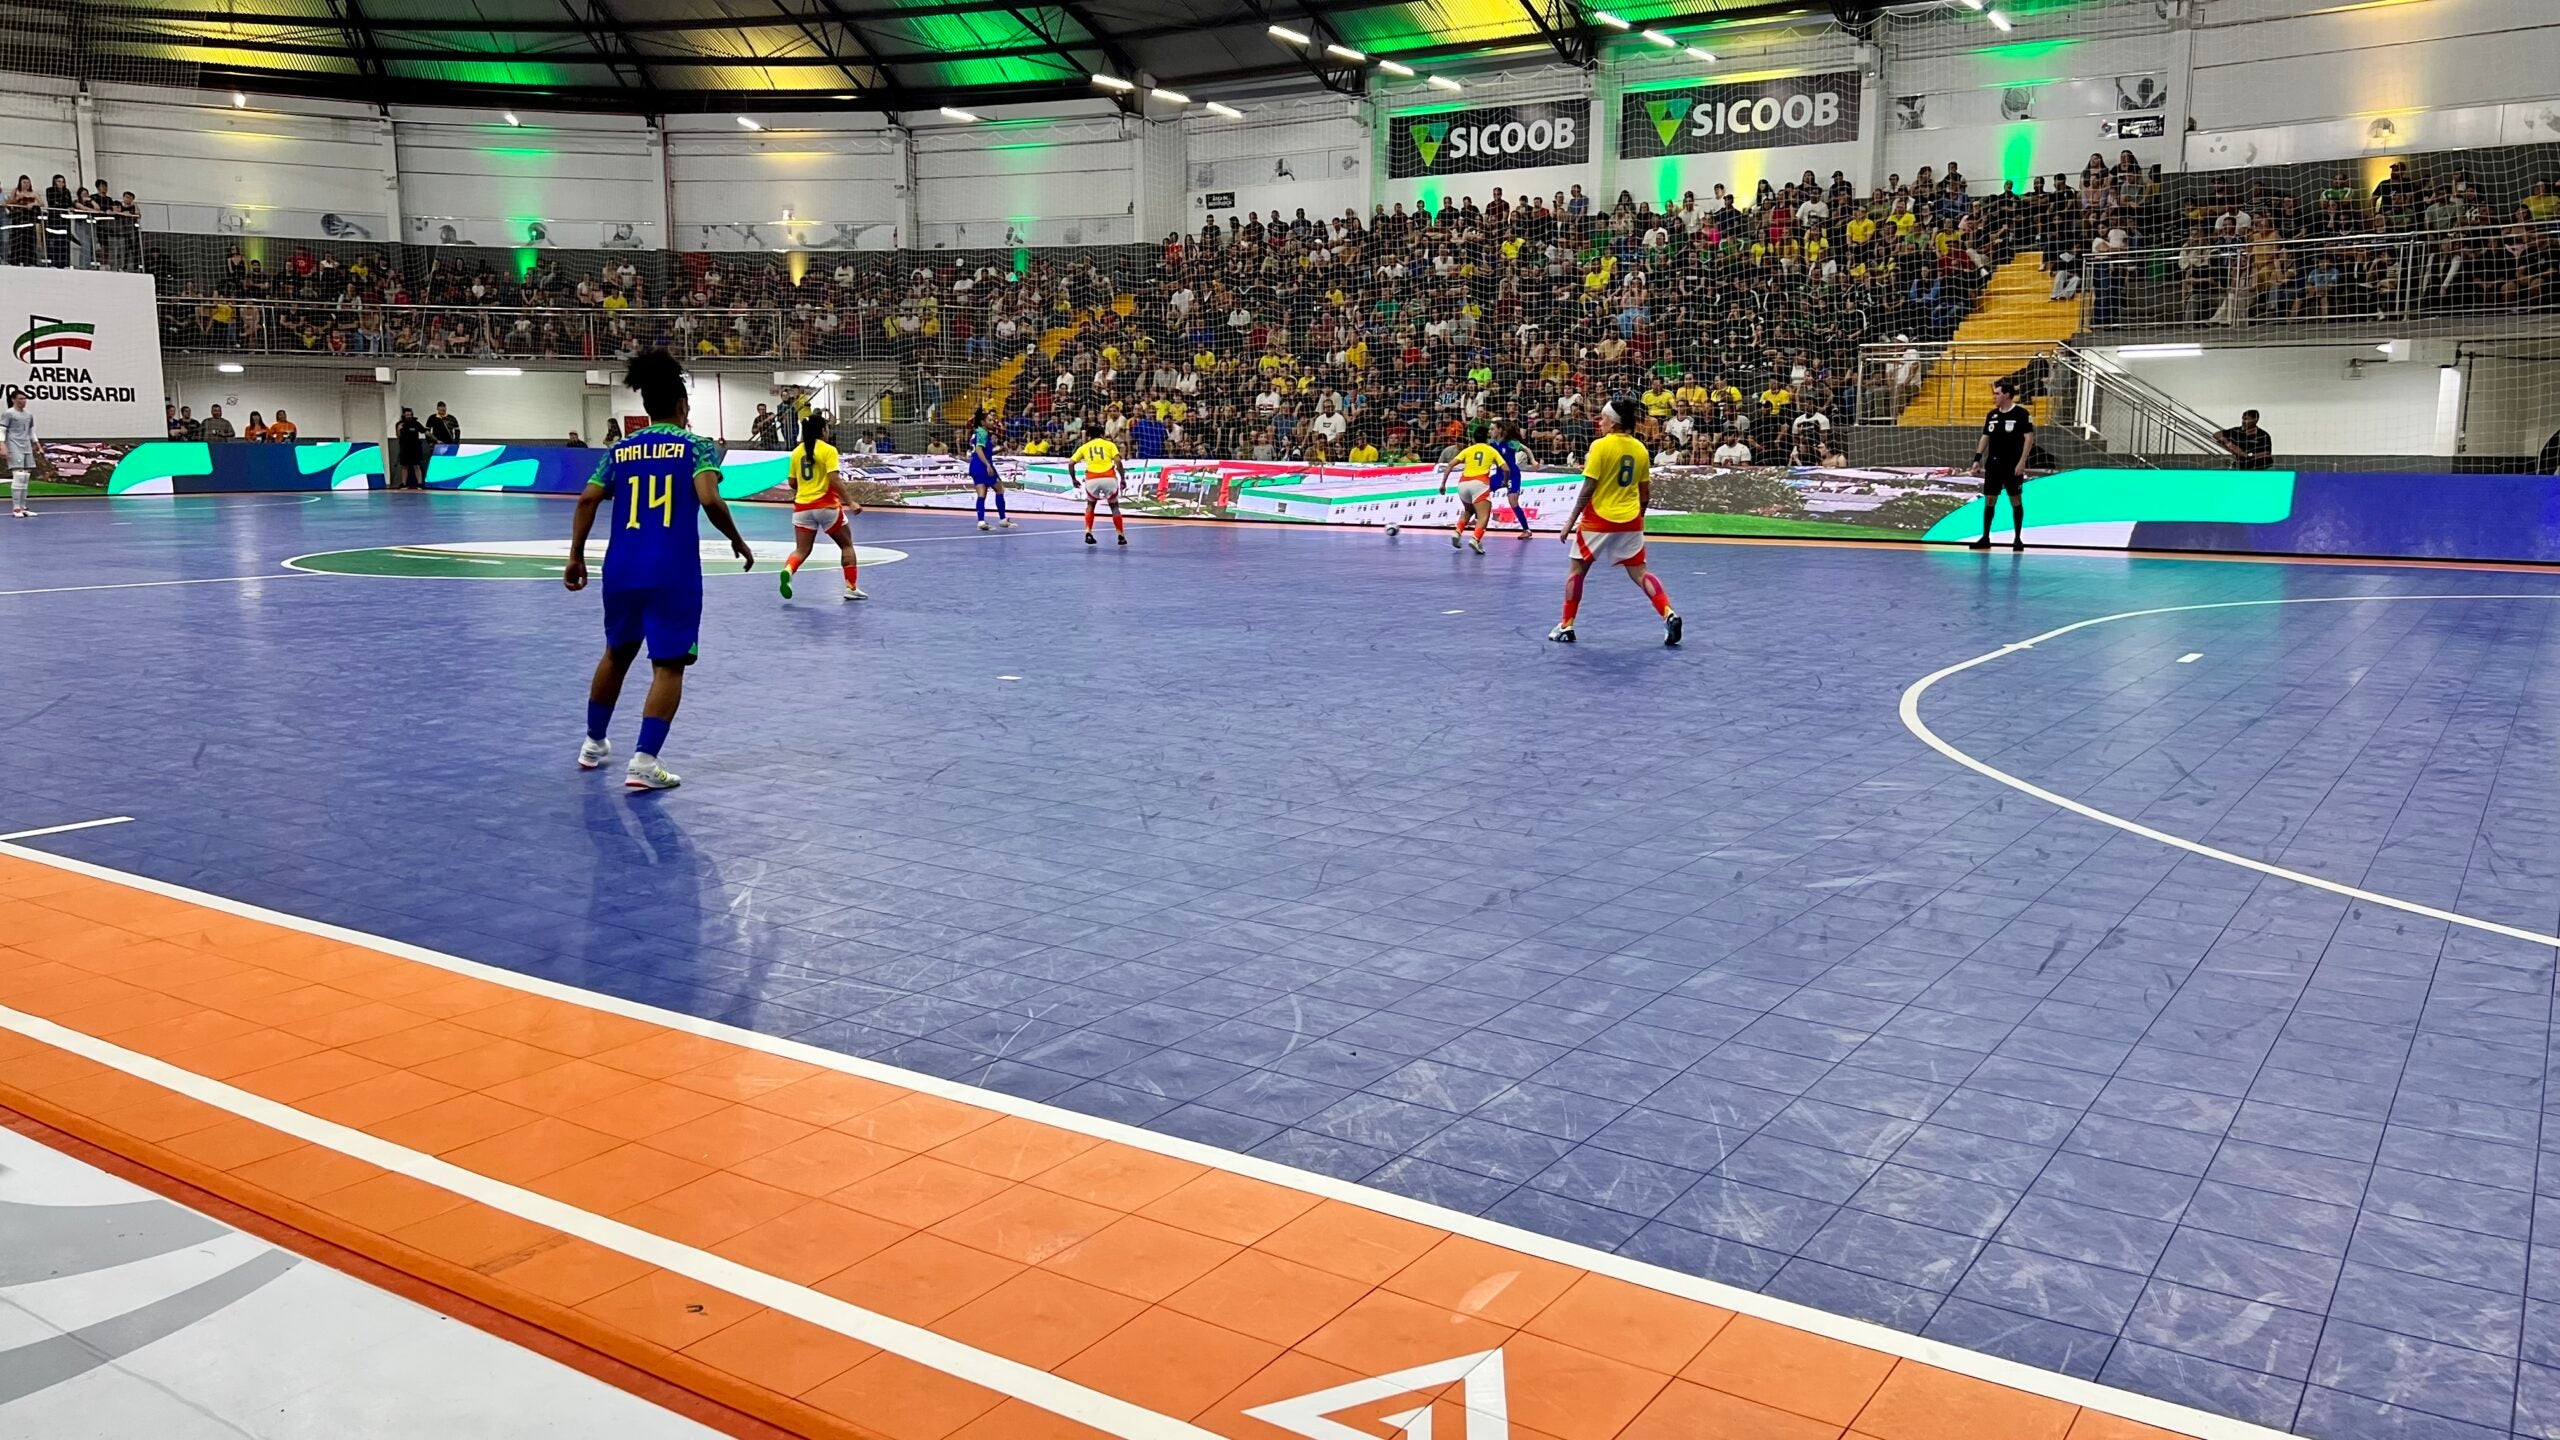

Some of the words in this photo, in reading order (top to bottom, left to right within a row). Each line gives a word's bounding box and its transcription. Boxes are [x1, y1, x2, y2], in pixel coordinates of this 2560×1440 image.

[1691, 92, 1839, 137] SICOOB
[1449, 117, 1576, 159] SICOOB
[28, 366, 93, 383] ARENA
[23, 385, 136, 402] SGUISSARDI
[615, 444, 642, 463] ANA
[643, 443, 685, 459] LUIZA
[1089, 446, 1105, 461] 14
[1474, 451, 1484, 467] 9
[1617, 454, 1635, 487] 8
[626, 474, 673, 530] 14
